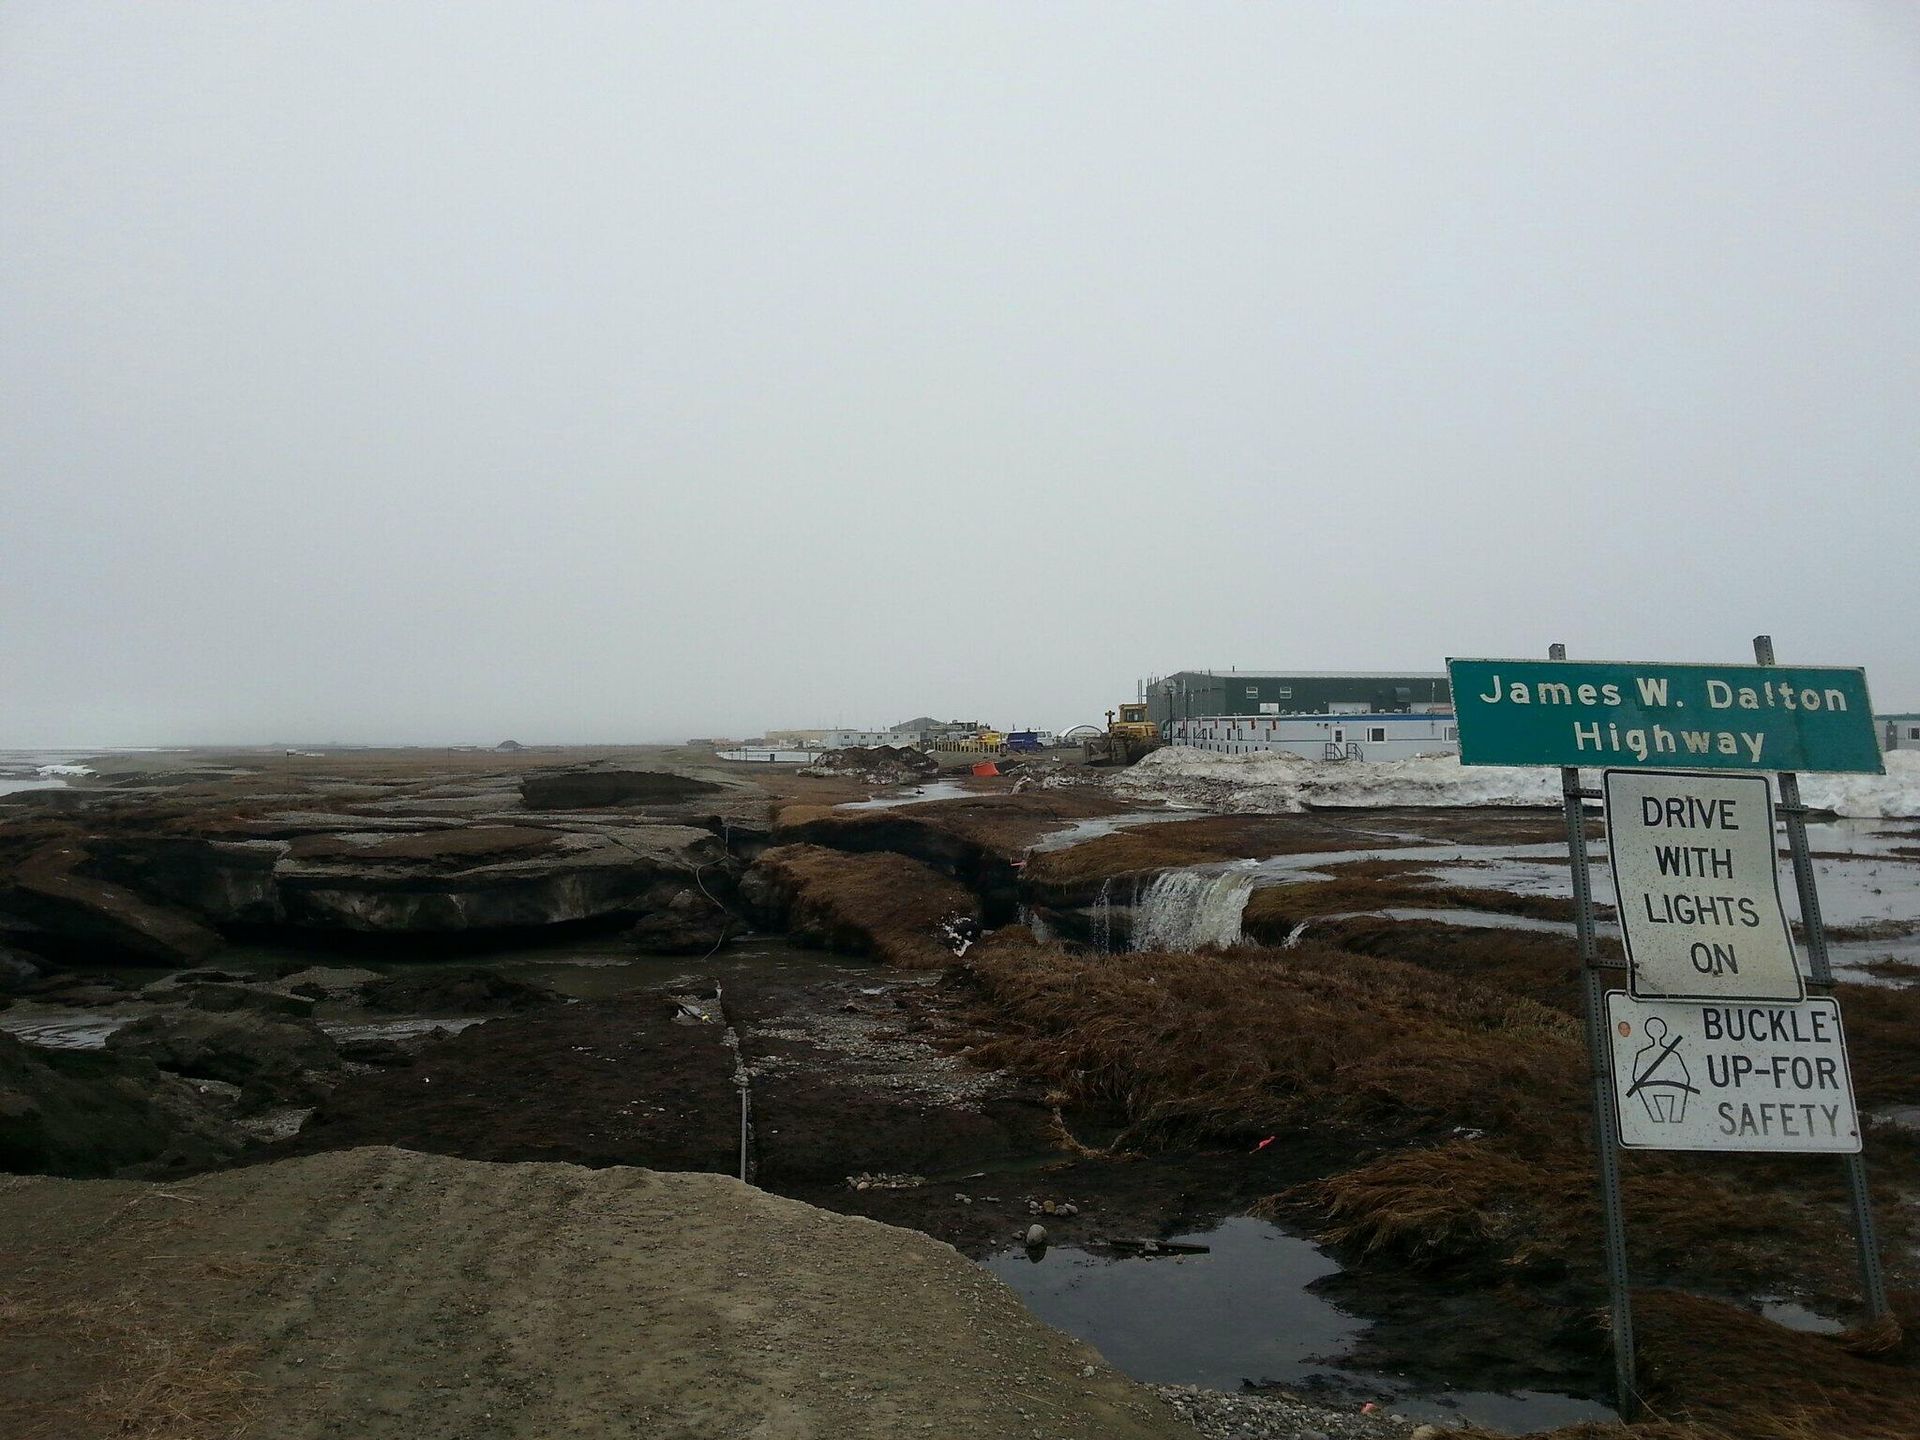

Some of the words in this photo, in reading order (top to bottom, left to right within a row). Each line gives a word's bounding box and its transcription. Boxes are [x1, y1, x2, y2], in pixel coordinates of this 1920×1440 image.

[1480, 674, 1622, 706] James
[1636, 678, 1684, 708] W.
[1707, 680, 1847, 711] Dalton
[1575, 722, 1766, 763] Highway
[1643, 796, 1739, 830] DRIVE
[1655, 846, 1734, 879] WITH
[1644, 893, 1760, 927] LIGHTS
[1690, 942, 1739, 975] ON
[1703, 1007, 1832, 1043] BUCKLE
[1707, 1055, 1840, 1090] UP-FOR
[1720, 1102, 1840, 1137] SAFETY
